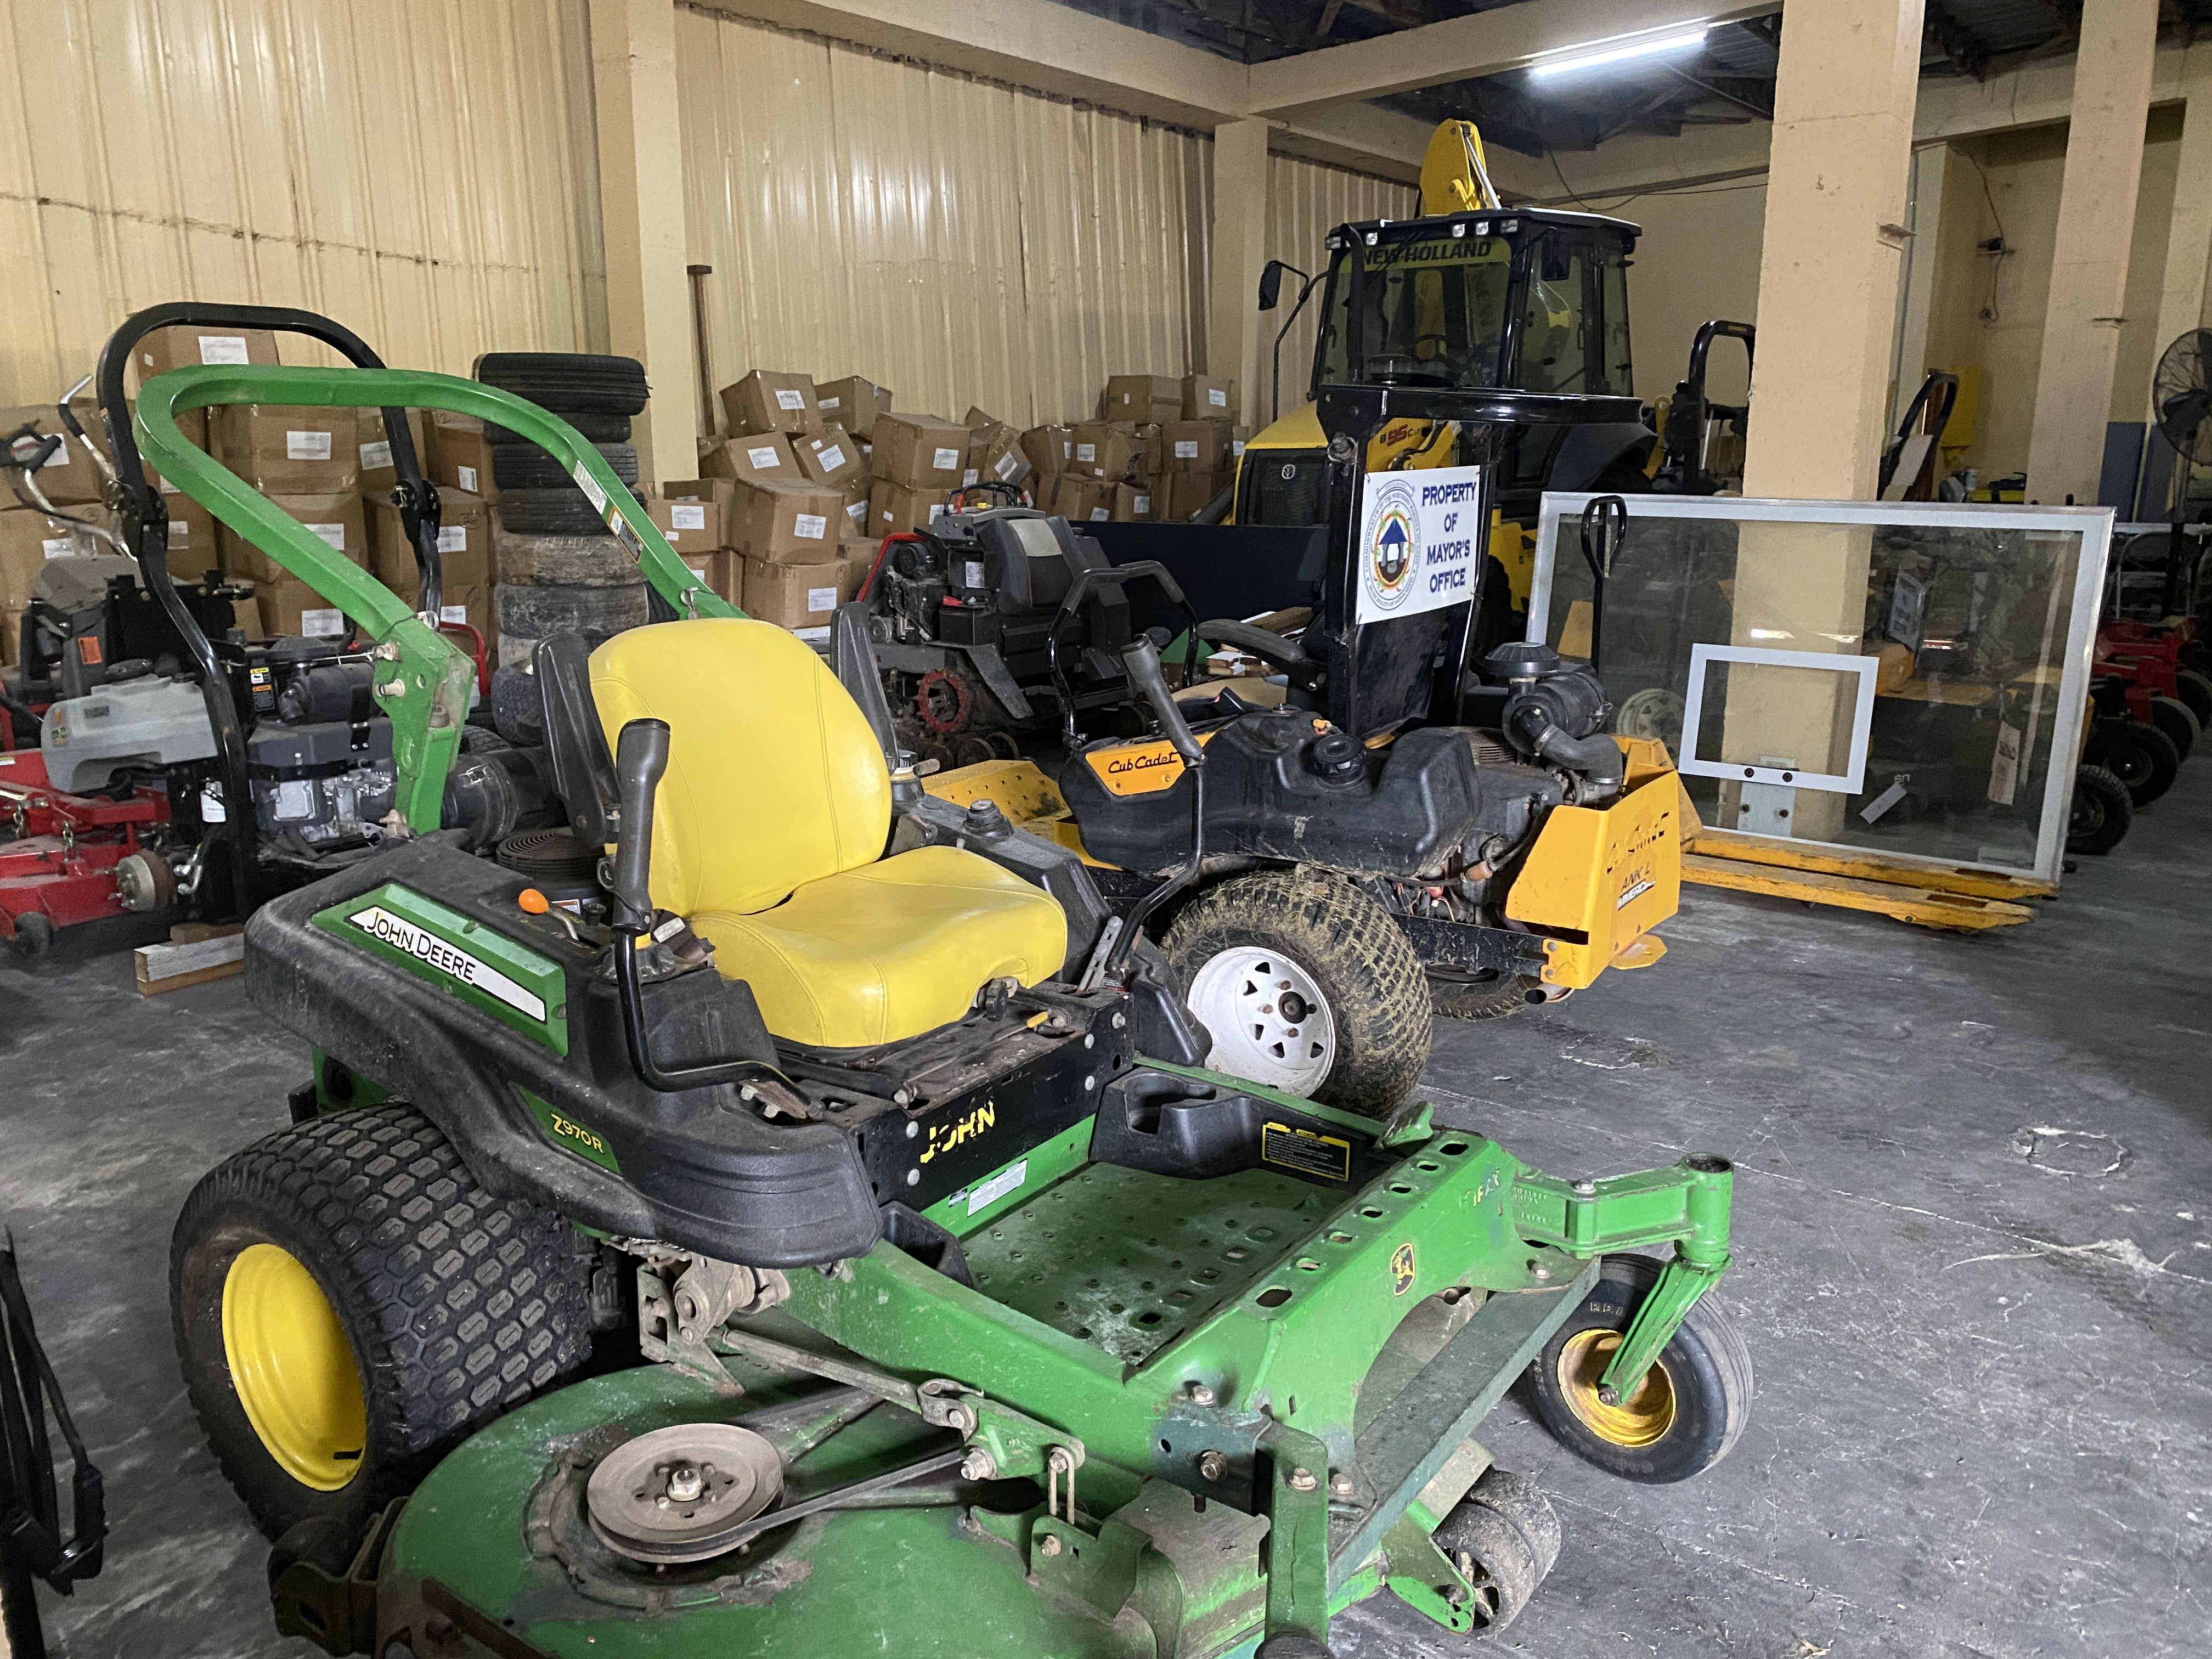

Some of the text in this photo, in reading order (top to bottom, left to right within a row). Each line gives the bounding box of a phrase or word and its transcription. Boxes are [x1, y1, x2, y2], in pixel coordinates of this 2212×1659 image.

[1403, 241, 1492, 262] HOLLAND
[1422, 482, 1476, 506] PROPERTY
[1444, 511, 1459, 533] OF
[1426, 539, 1471, 566] MAYOR'S
[1430, 567, 1466, 592] OFFICE
[1108, 752, 1180, 774] Cub Cadet
[366, 912, 476, 981] JOHN DEERE
[550, 1113, 603, 1154] Z970R
